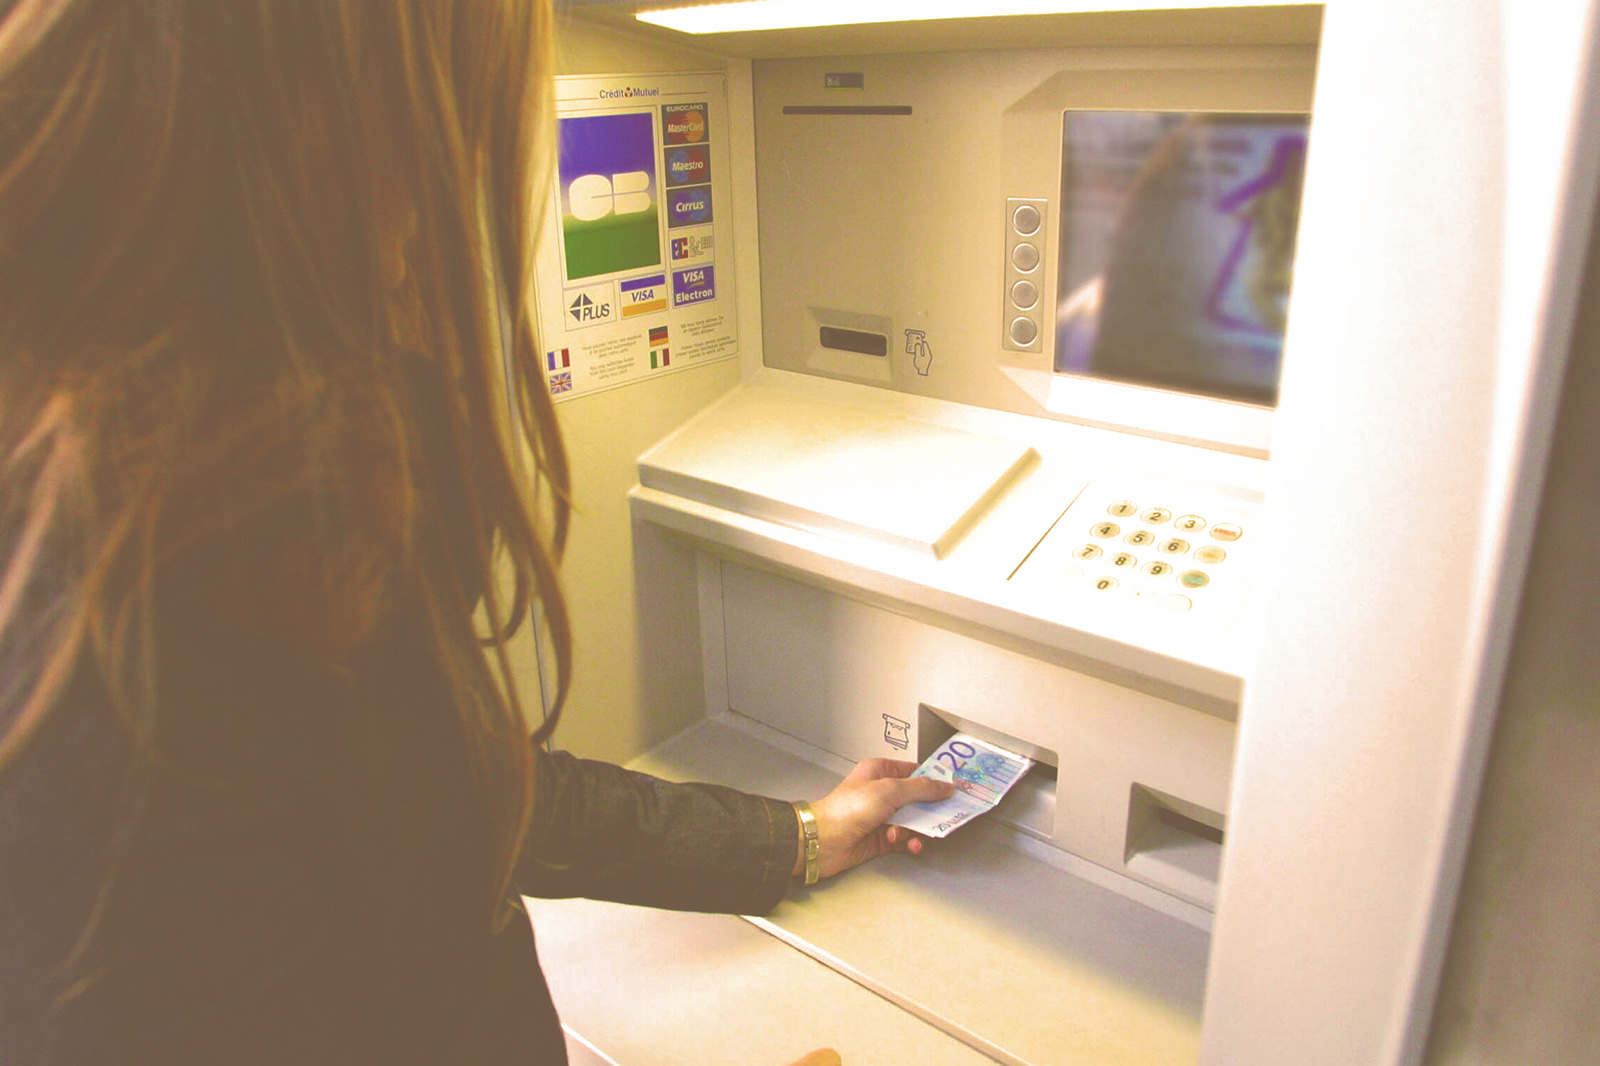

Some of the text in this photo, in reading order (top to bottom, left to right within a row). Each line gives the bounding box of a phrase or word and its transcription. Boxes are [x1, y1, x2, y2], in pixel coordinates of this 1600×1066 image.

[633, 87, 660, 97] Mutuel
[665, 104, 704, 112] EUROCARD
[667, 122, 703, 134] MasterCard
[671, 160, 704, 172] Maestro
[675, 201, 705, 213] Cirrus
[682, 270, 705, 283] VISA
[630, 289, 655, 303] VISA
[675, 288, 713, 303] Electron
[582, 303, 610, 322] PLUS
[1119, 505, 1128, 513] 1
[1150, 512, 1162, 521] 2
[1185, 519, 1196, 529] 3
[1099, 526, 1111, 535] 4
[1133, 534, 1146, 543] 5
[1168, 542, 1180, 551] 6
[1081, 547, 1094, 557] 7
[1114, 556, 1127, 566] 8
[1150, 565, 1162, 575] 9
[1096, 580, 1109, 590] 0
[936, 740, 976, 772] 20
